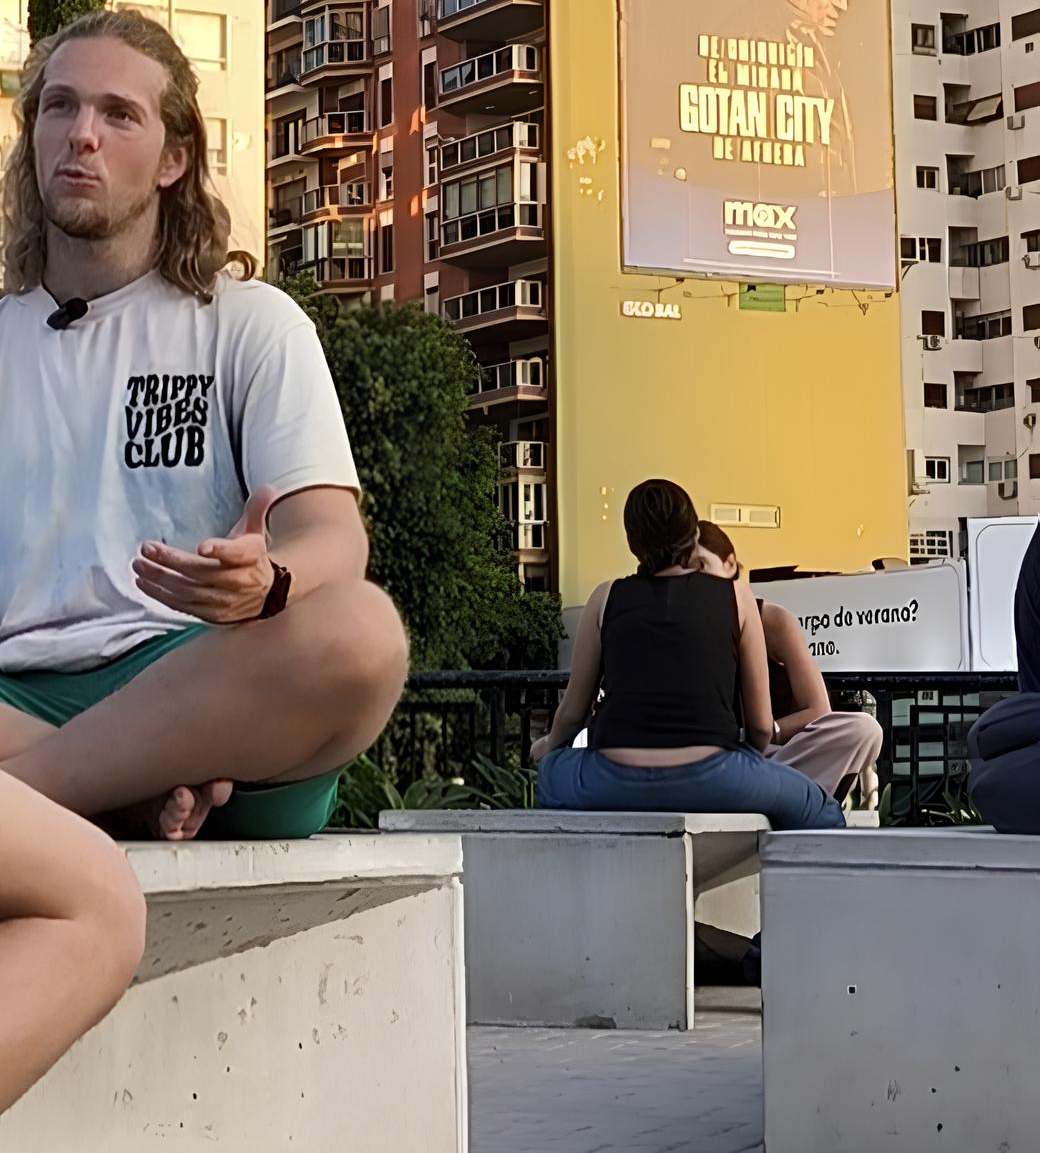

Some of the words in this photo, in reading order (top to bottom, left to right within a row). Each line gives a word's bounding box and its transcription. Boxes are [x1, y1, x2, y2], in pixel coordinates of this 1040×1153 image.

[680, 84, 767, 139] GOTAN
[776, 94, 835, 145] CITY
[724, 200, 797, 230] max
[127, 374, 215, 407] TRIPPY
[125, 397, 208, 440] VIBES
[124, 425, 205, 469] CLUB
[834, 606, 853, 627] de
[856, 599, 919, 625] verano?
